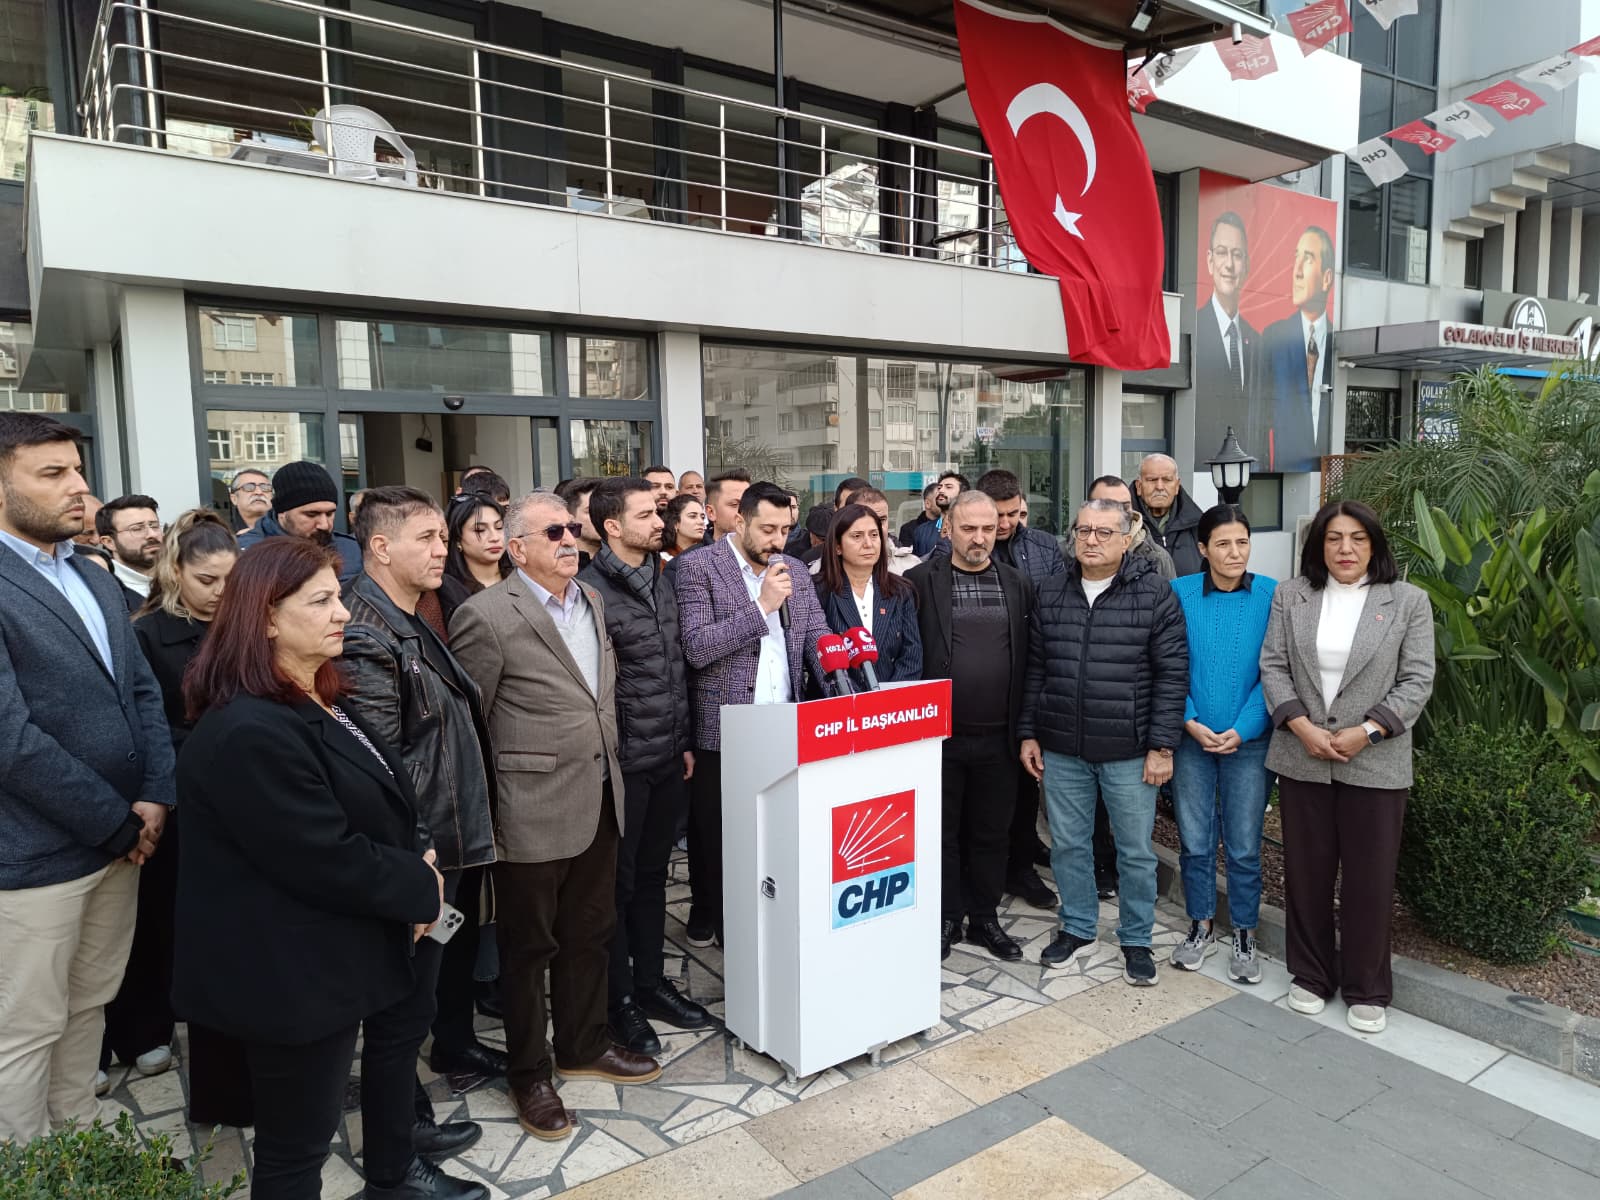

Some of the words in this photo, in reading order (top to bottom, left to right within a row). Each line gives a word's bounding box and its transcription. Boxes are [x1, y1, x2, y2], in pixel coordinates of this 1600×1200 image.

[814, 721, 843, 738] CHP
[846, 716, 859, 733] İL
[861, 703, 939, 730] BAŞKANLIĞI
[838, 872, 909, 919] CHP
